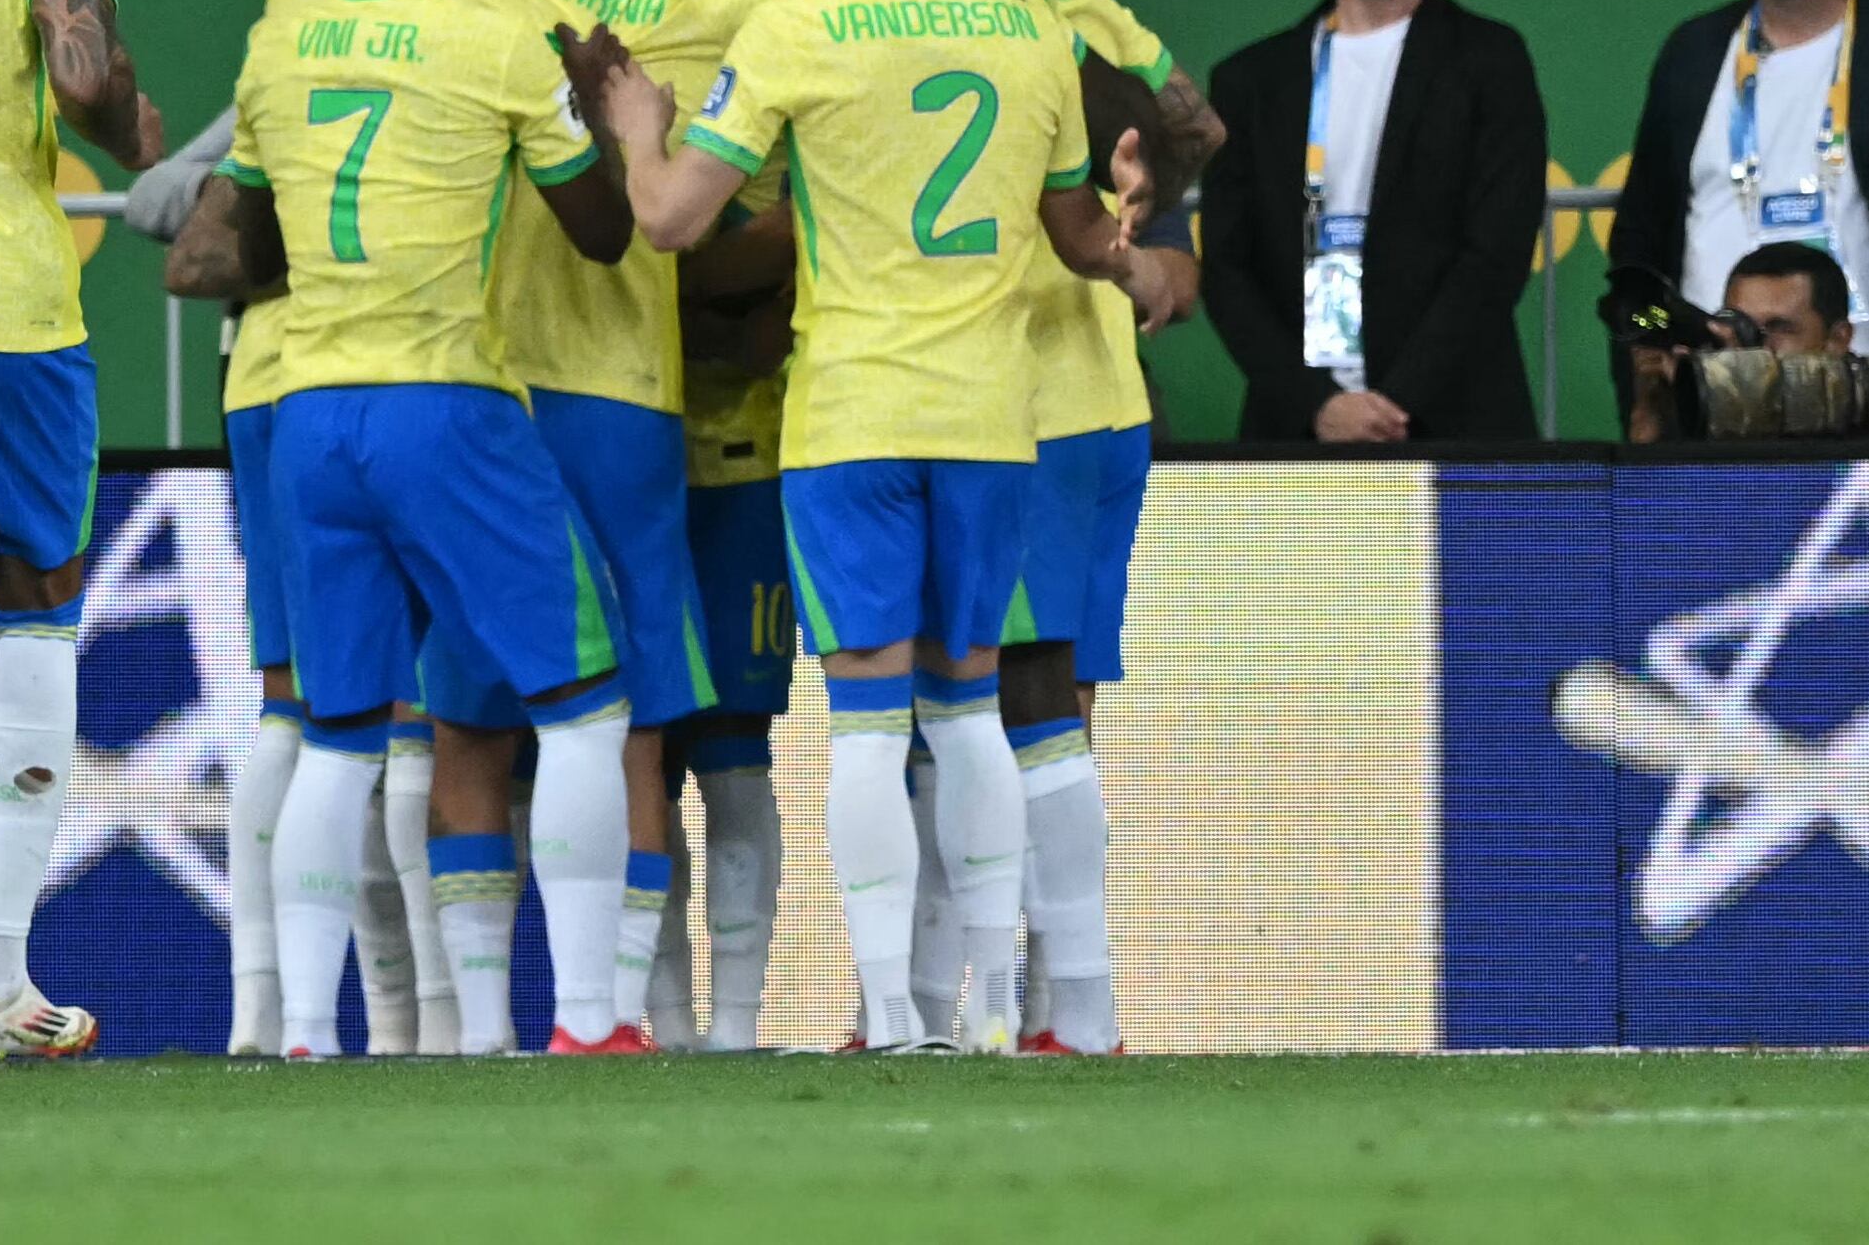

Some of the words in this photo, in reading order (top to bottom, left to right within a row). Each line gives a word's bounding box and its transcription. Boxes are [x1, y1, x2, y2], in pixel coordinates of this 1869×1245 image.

[297, 18, 358, 59] VINI
[366, 22, 425, 63] JR.
[821, 0, 1039, 43] VANDERSON
[308, 89, 392, 263] 7
[911, 70, 999, 255] 2
[751, 581, 792, 655] 10
